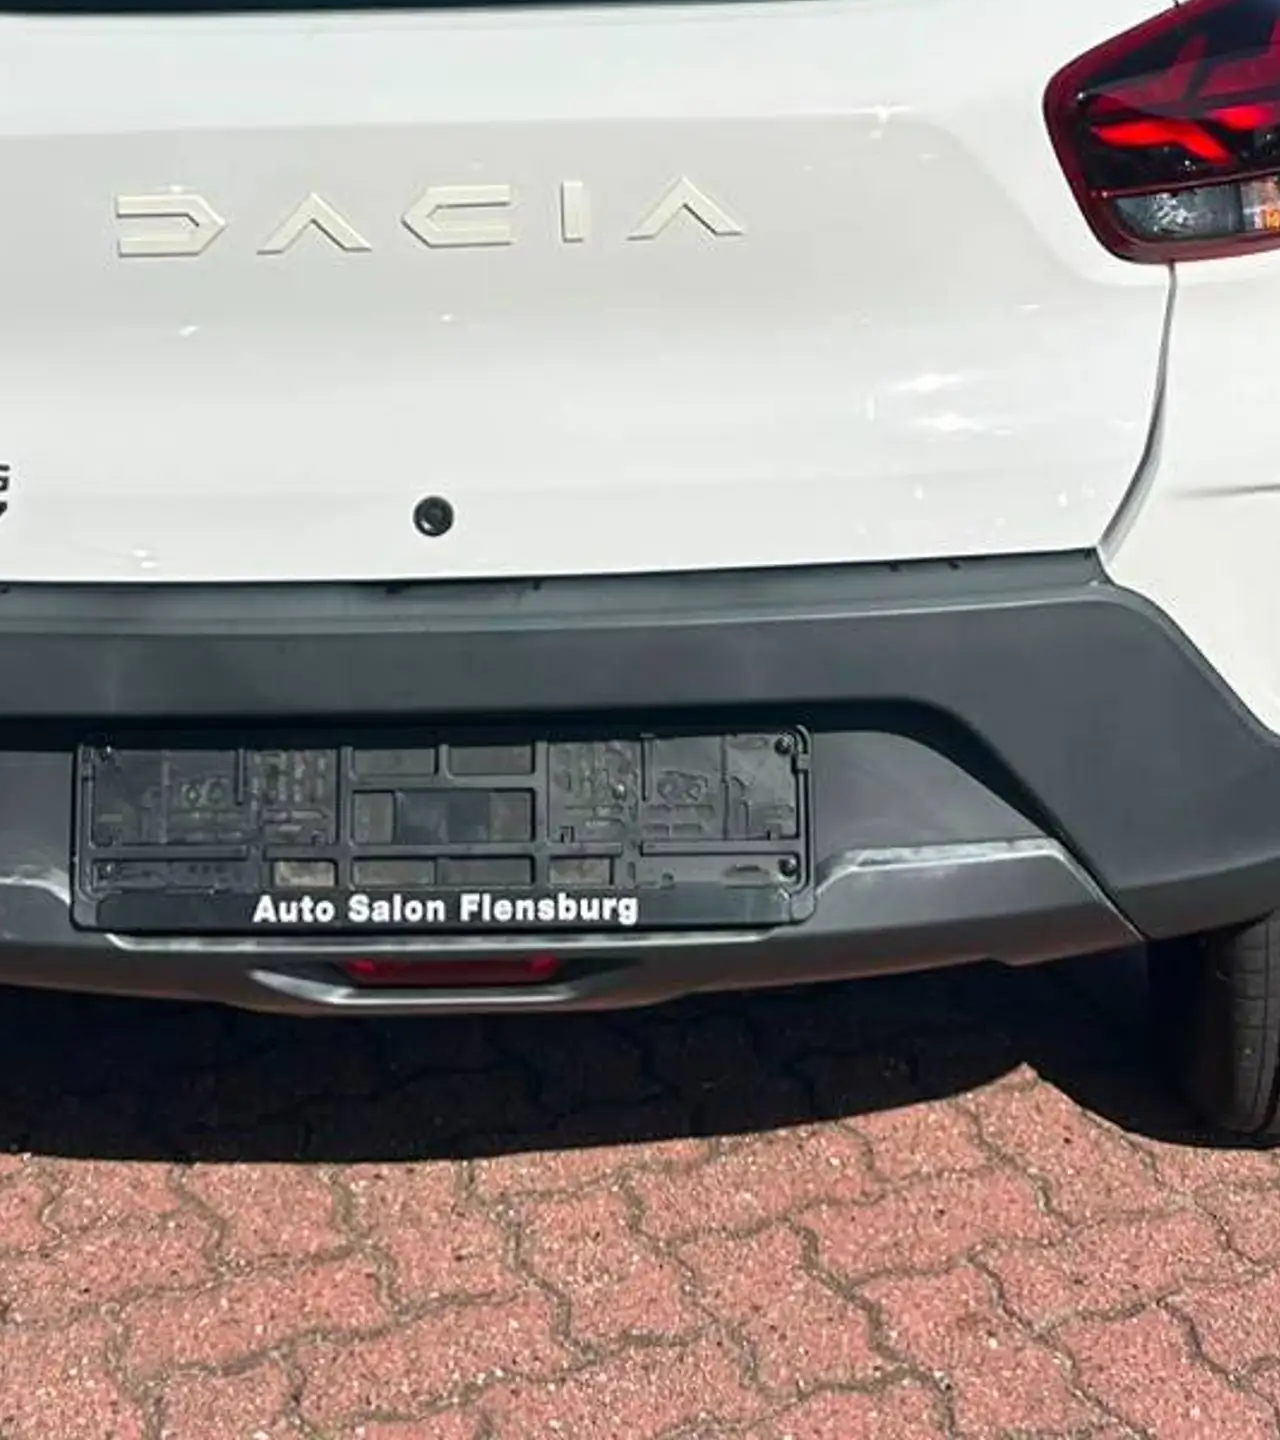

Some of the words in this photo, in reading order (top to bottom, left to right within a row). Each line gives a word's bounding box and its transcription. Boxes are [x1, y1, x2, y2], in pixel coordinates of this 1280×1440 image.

[117, 176, 745, 256] DACIA
[253, 894, 335, 923] Auto
[348, 895, 446, 923] Salon
[459, 894, 639, 925] Flensburg
